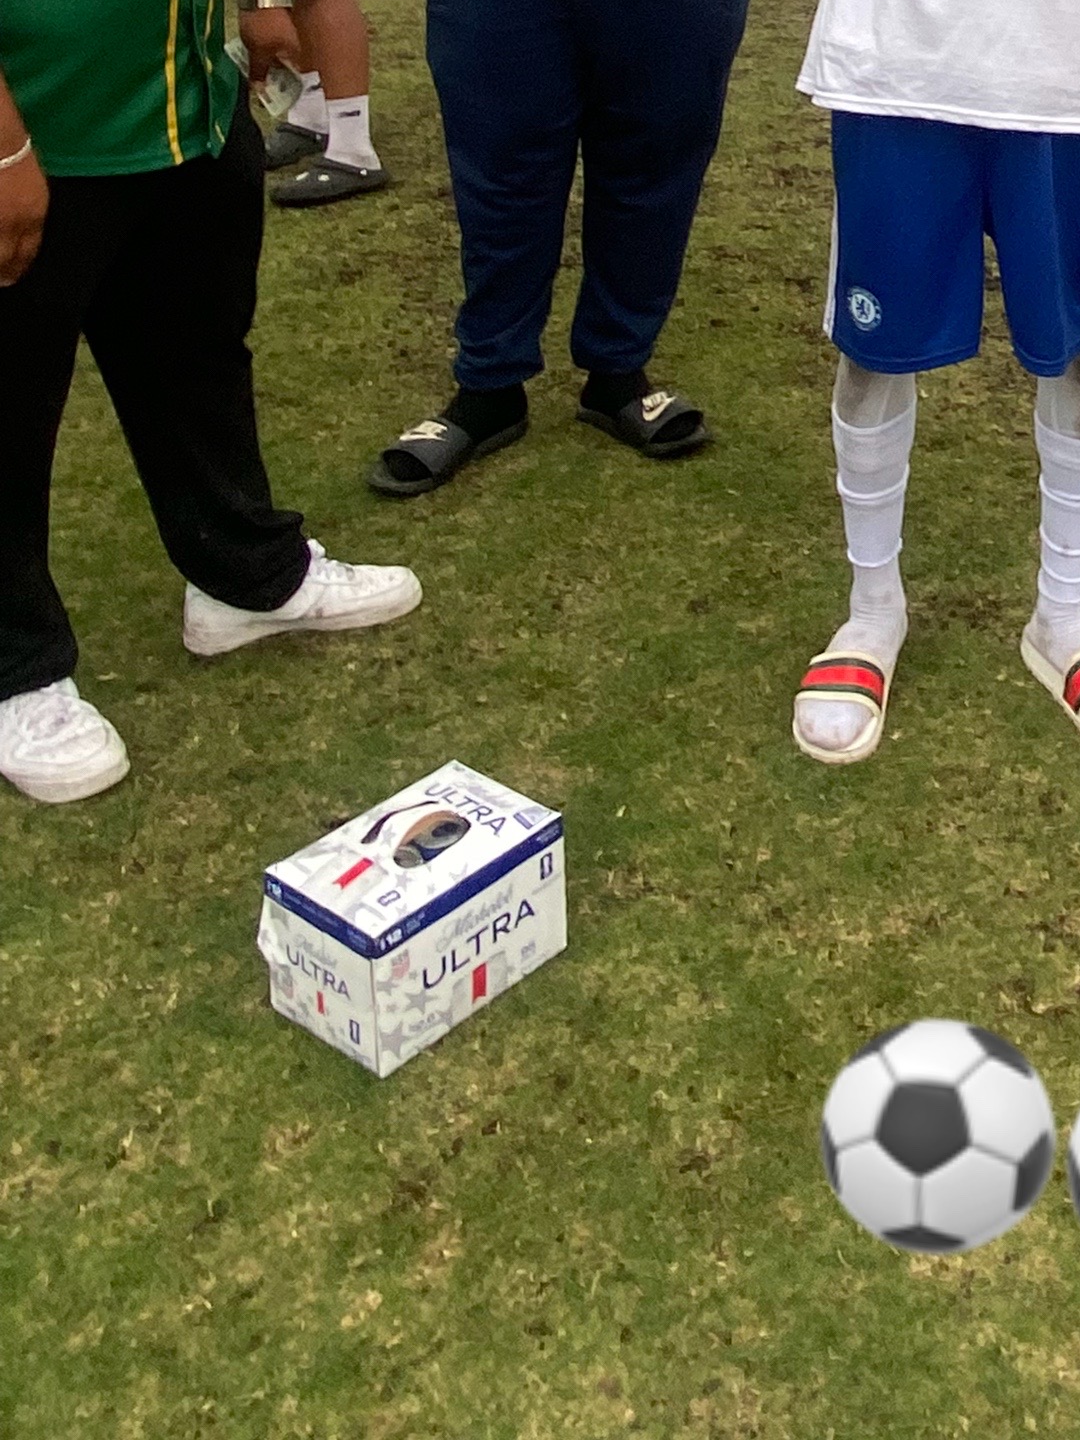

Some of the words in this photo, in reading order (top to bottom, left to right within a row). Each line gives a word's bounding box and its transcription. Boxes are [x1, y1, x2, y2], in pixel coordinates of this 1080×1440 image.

[425, 783, 506, 835] ULTRA
[286, 944, 353, 1001] ULTRA
[422, 898, 535, 990] ULTRA
